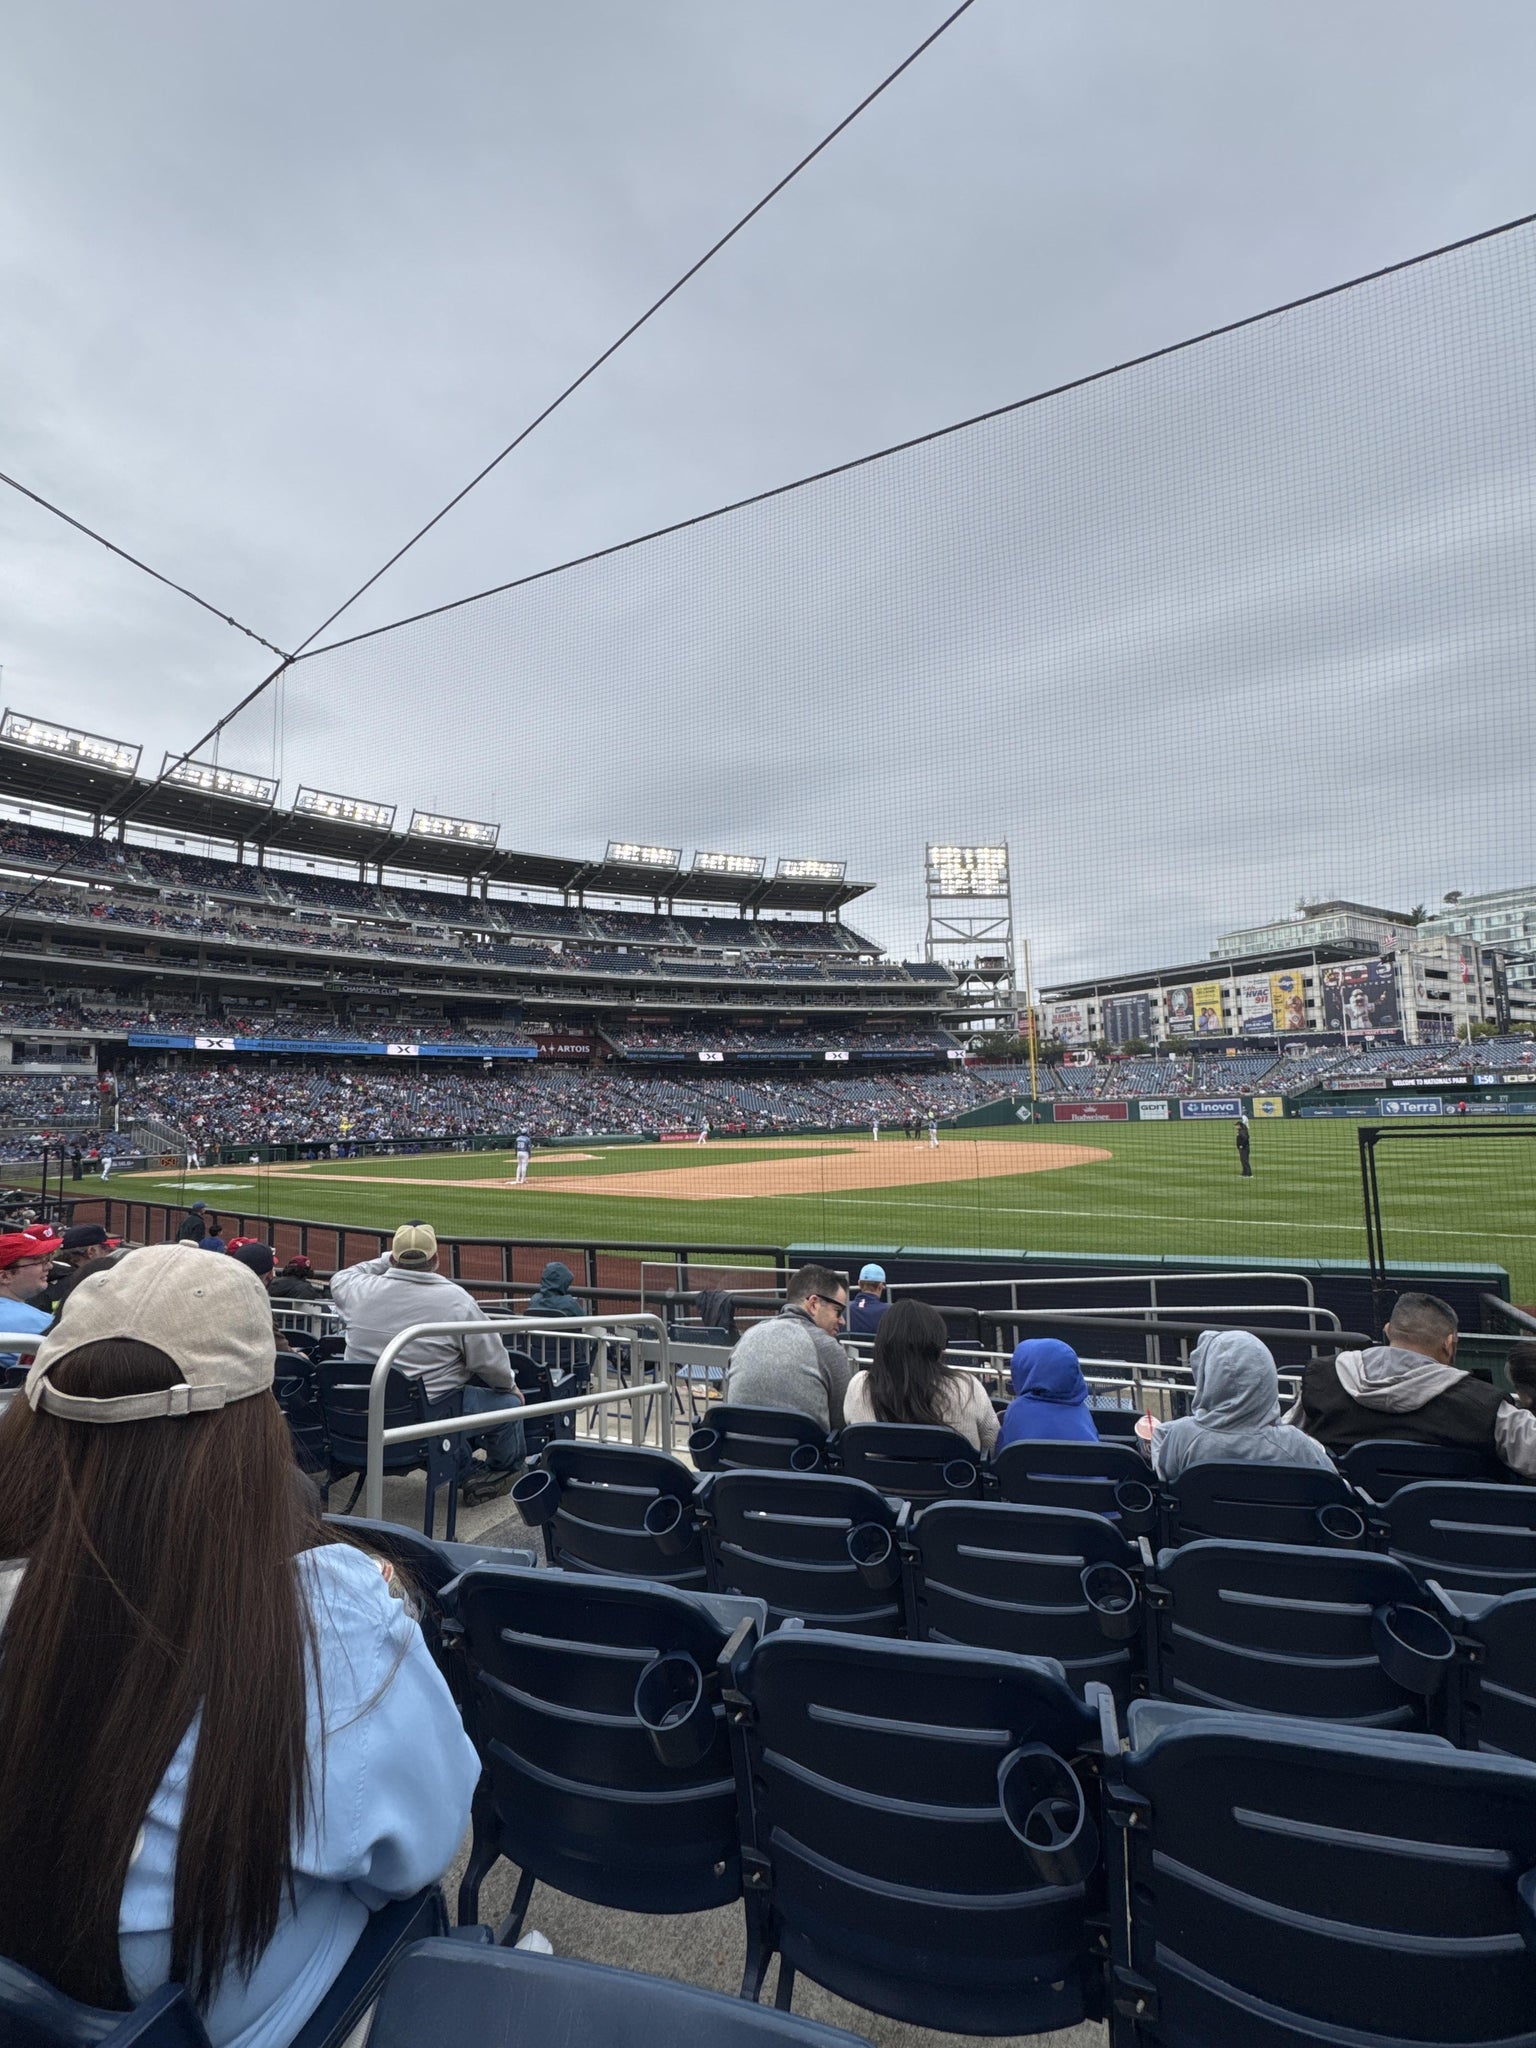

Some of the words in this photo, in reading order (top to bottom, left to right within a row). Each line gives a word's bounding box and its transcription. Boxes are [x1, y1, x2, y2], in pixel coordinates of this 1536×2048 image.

[343, 985, 380, 995] CHAMPIONS
[381, 988, 398, 996] CLUB
[1246, 989, 1269, 998] HVAC
[1255, 996, 1269, 1004] 911
[557, 1045, 590, 1053] ARTOIS
[1392, 1079, 1415, 1087] WELCOME
[1424, 1078, 1452, 1086] NATIONALS
[1452, 1077, 1467, 1085] PARK
[1477, 1075, 1494, 1084] 1:50
[1338, 1081, 1360, 1089] Harris
[1360, 1080, 1384, 1088] Teeter
[1201, 1103, 1234, 1112] Inova
[1401, 1102, 1437, 1112] Terra
[1071, 1113, 1109, 1121] Budweiser
